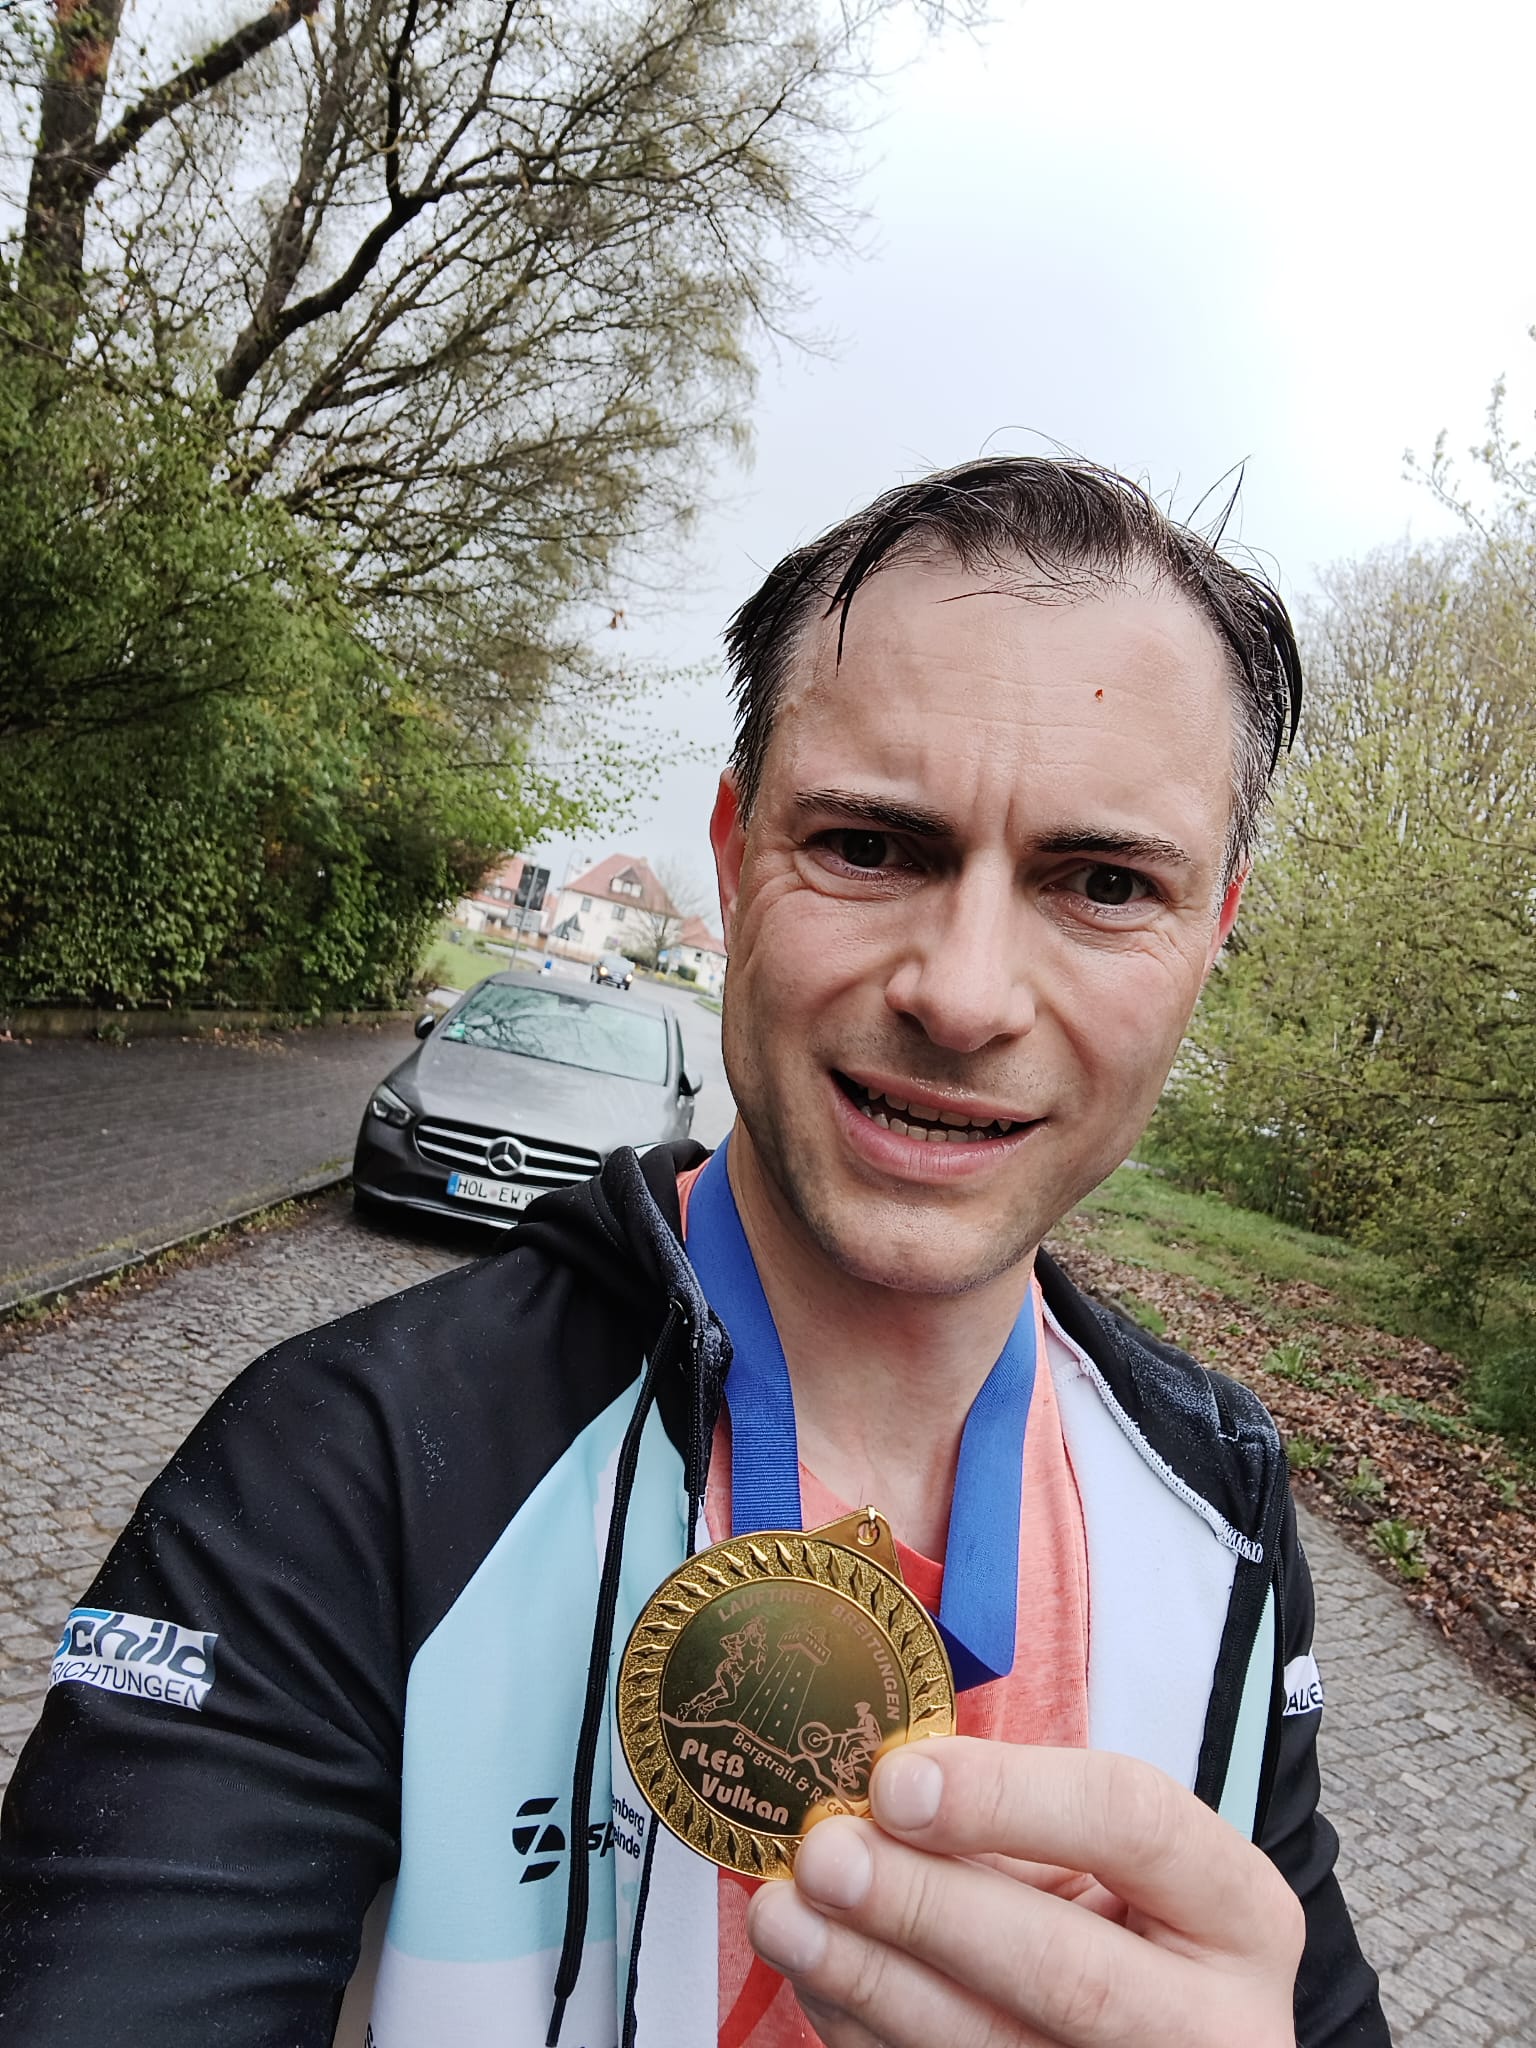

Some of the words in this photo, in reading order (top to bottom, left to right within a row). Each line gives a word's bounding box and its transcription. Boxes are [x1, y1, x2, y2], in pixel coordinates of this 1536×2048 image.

[457, 1178, 487, 1199] HOL
[498, 1186, 521, 1205] EW
[831, 1602, 901, 1721] BREITUNGEN
[732, 1731, 797, 1785] Bergtrail
[795, 1776, 810, 1792] &
[700, 1773, 789, 1826] Vulkan
